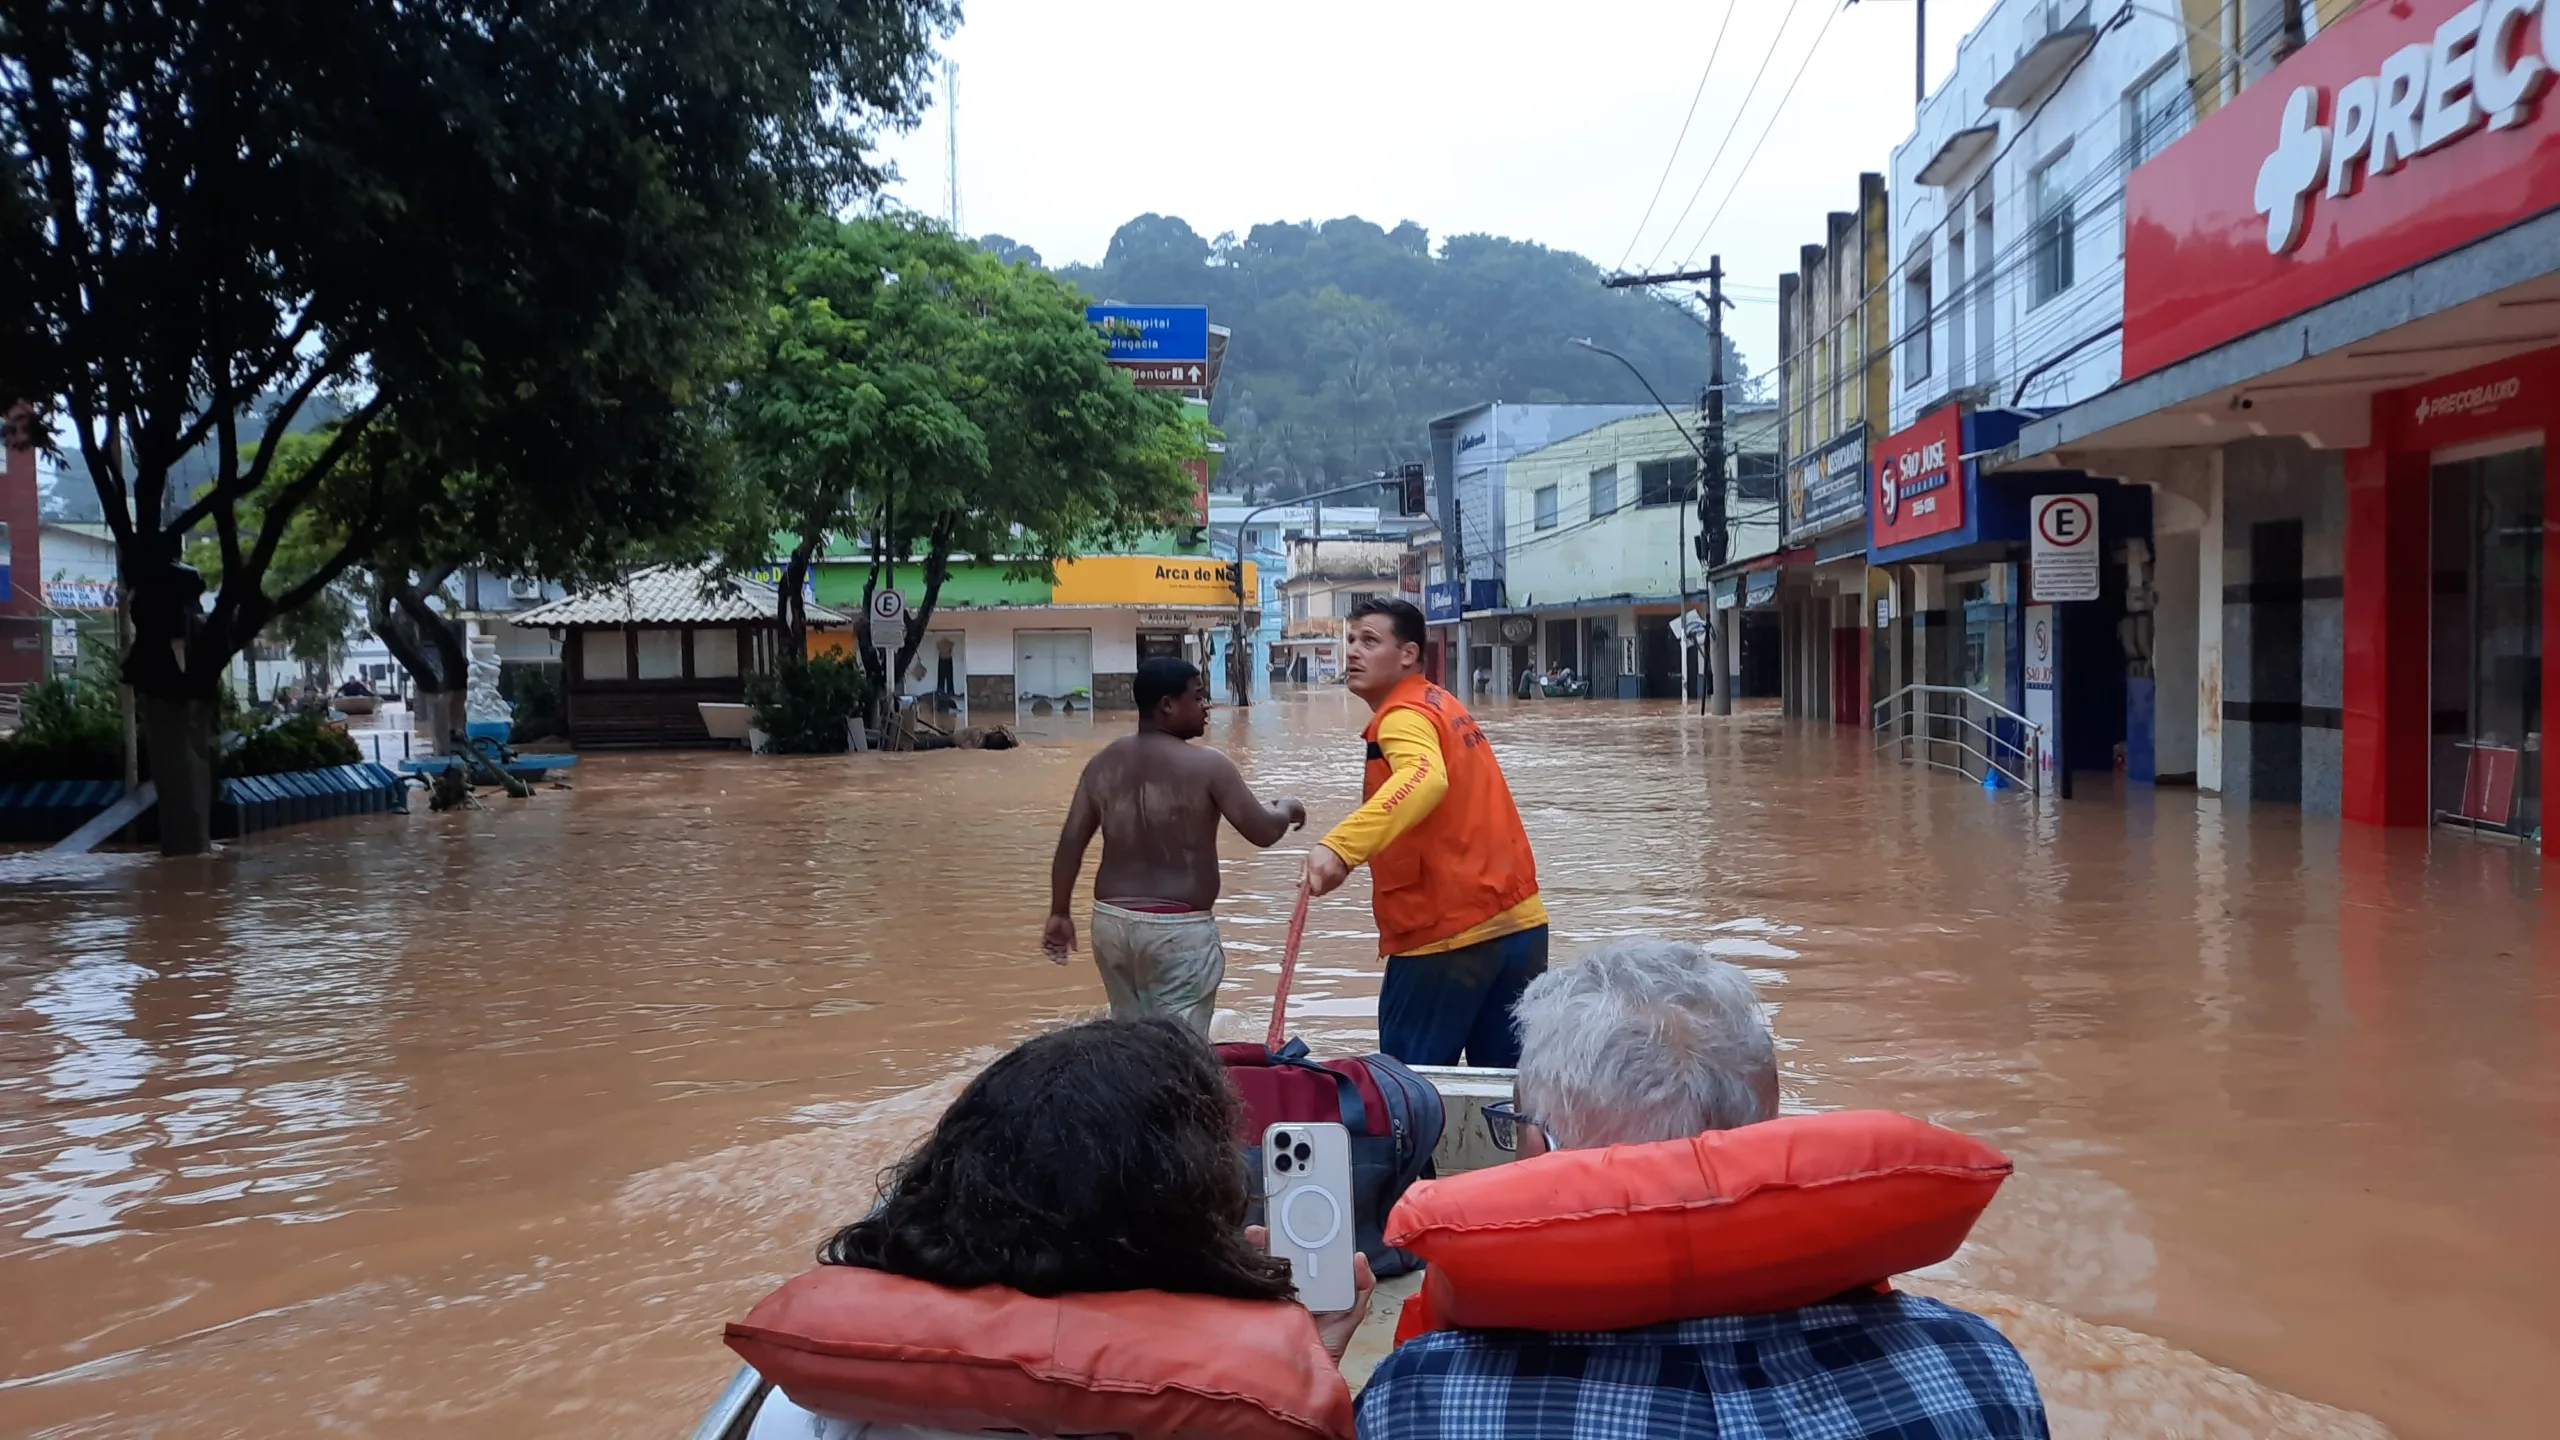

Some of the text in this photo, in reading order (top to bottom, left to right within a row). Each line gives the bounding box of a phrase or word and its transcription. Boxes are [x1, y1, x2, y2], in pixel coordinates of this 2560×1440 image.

[1109, 338, 1159, 351] elegacia
[1133, 369, 1171, 380] dentor
[1900, 447, 1920, 481] SÃO
[2056, 508, 2074, 536] E
[1155, 564, 1189, 580] Arca
[882, 596, 893, 613] E
